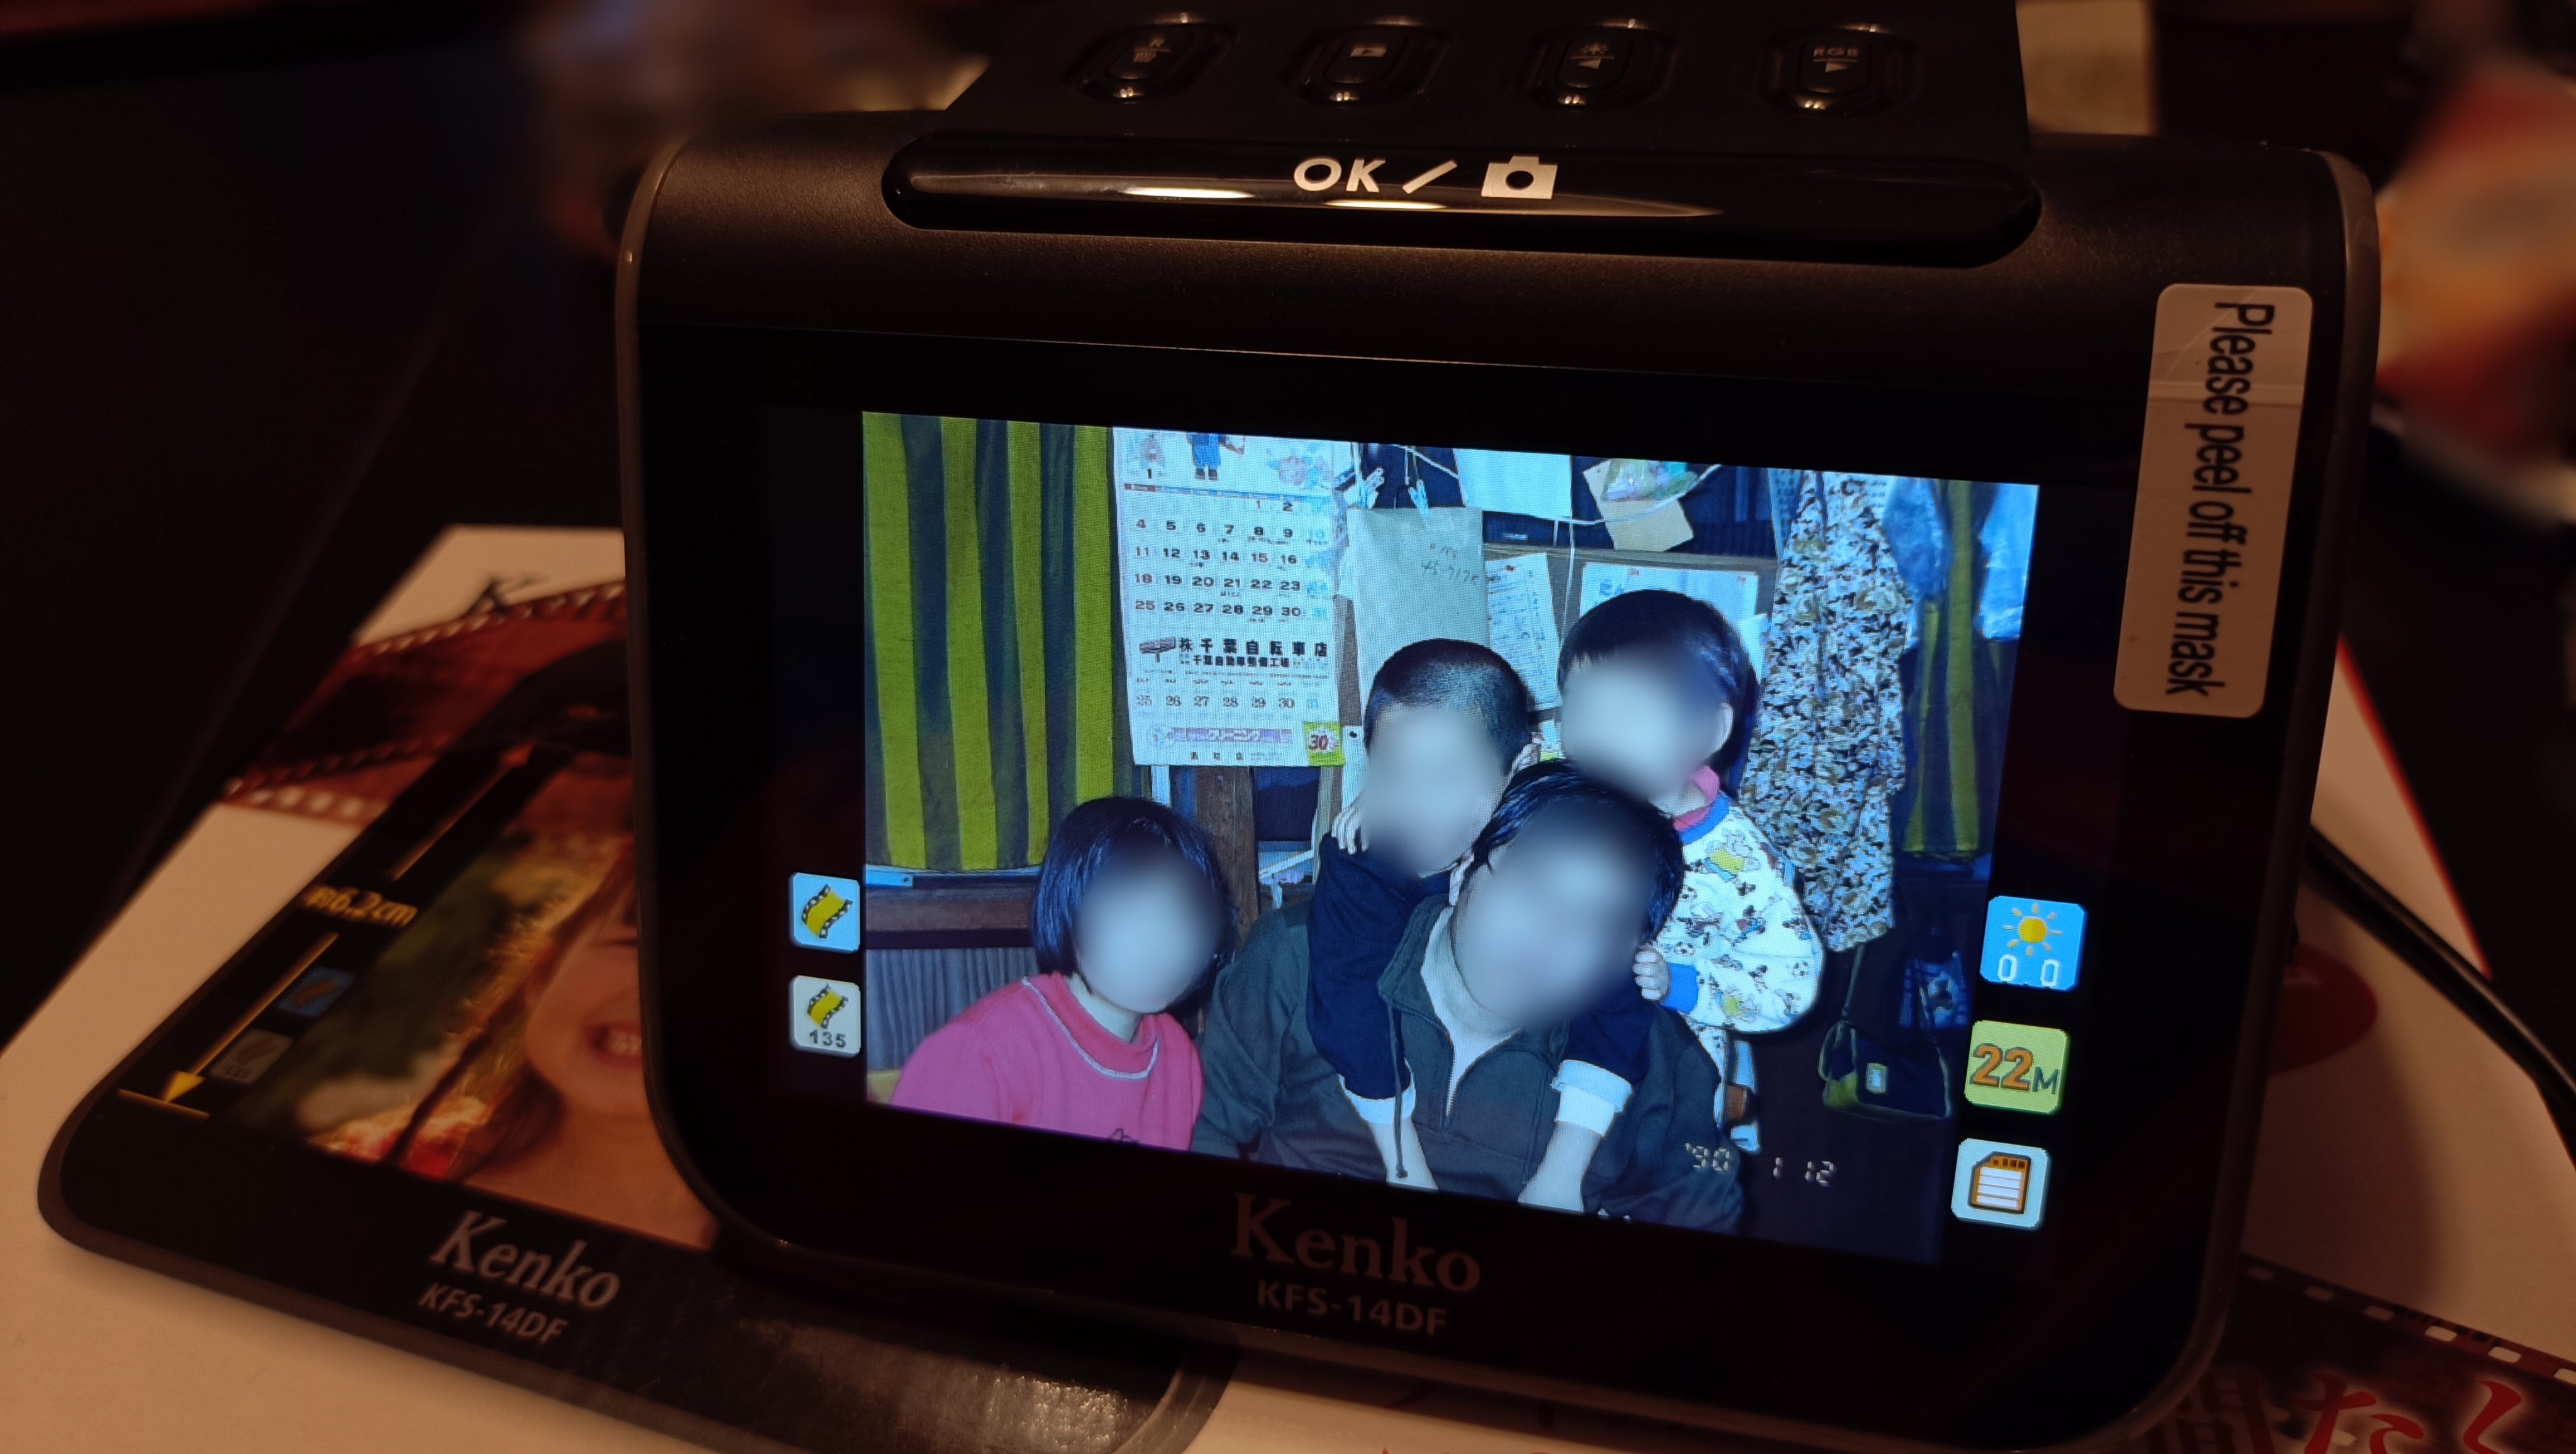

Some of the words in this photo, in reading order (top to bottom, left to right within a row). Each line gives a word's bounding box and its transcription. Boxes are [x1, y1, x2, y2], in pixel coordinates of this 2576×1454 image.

[1294, 157, 1386, 193] OK
[2202, 302, 2275, 415] Please
[2184, 423, 2252, 494] peel
[1136, 519, 1146, 528] 4
[1166, 521, 1176, 530] 5
[1196, 522, 1206, 533] 6
[1224, 524, 1235, 534] 7
[1254, 526, 1263, 536] 8
[1284, 528, 1293, 538] 9
[1282, 500, 1294, 513] 2
[2186, 501, 2248, 545] off
[1136, 546, 1149, 556] 11
[1163, 548, 1180, 558] 12
[1194, 550, 1210, 560] 13
[1222, 551, 1239, 561] 14
[1251, 552, 1268, 562] 15
[1281, 554, 1297, 563] 16
[2177, 549, 2242, 604] this
[1135, 574, 1152, 584] 18
[1165, 575, 1182, 584] 19
[1192, 576, 1214, 586] 20
[1224, 578, 1240, 587] 21
[1251, 579, 1272, 589] 22
[1280, 580, 1300, 590] 23
[1135, 600, 1155, 611] 25
[1164, 602, 1185, 611] 26
[1194, 602, 1214, 613] 27
[1223, 604, 1244, 614] 28
[1253, 606, 1273, 615] 29
[1280, 606, 1302, 618] 30
[2165, 611, 2226, 697] mask
[1308, 734, 1329, 751] 30
[809, 1029, 847, 1048] 135
[1970, 1042, 2059, 1096] 22M
[1804, 1160, 1836, 1186] 12
[428, 1209, 621, 1309] Kenko
[1231, 1192, 1481, 1293] Kenko
[418, 1282, 569, 1346] KFS-14DF
[1258, 1278, 1447, 1335] KFS-14DF
